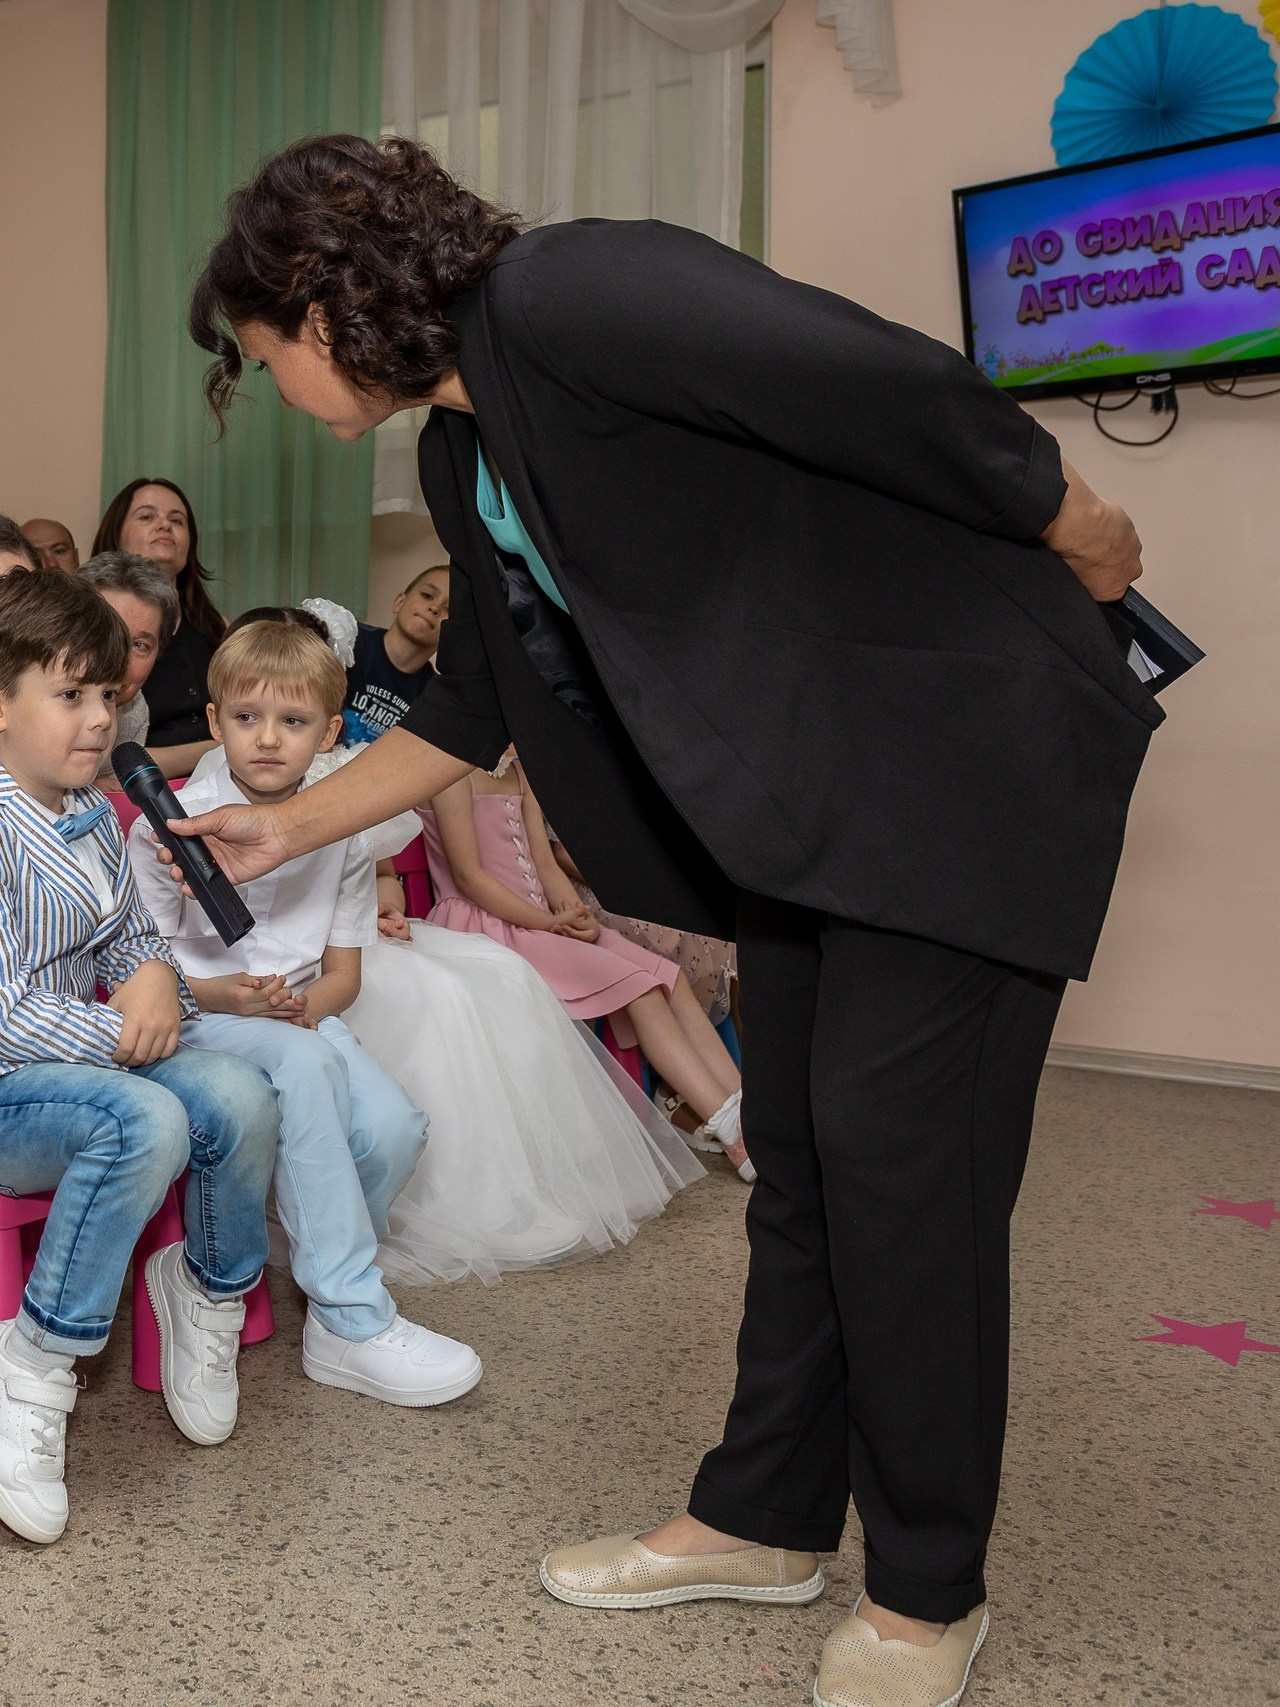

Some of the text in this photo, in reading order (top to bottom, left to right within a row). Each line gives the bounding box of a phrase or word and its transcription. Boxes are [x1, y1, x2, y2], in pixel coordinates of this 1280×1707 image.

[1007, 188, 1280, 276] ДО СВИДАНИЯ
[1017, 246, 1280, 323] ДЕТСКИЙ САД
[1136, 372, 1172, 384] DNS
[351, 691, 368, 710] LO
